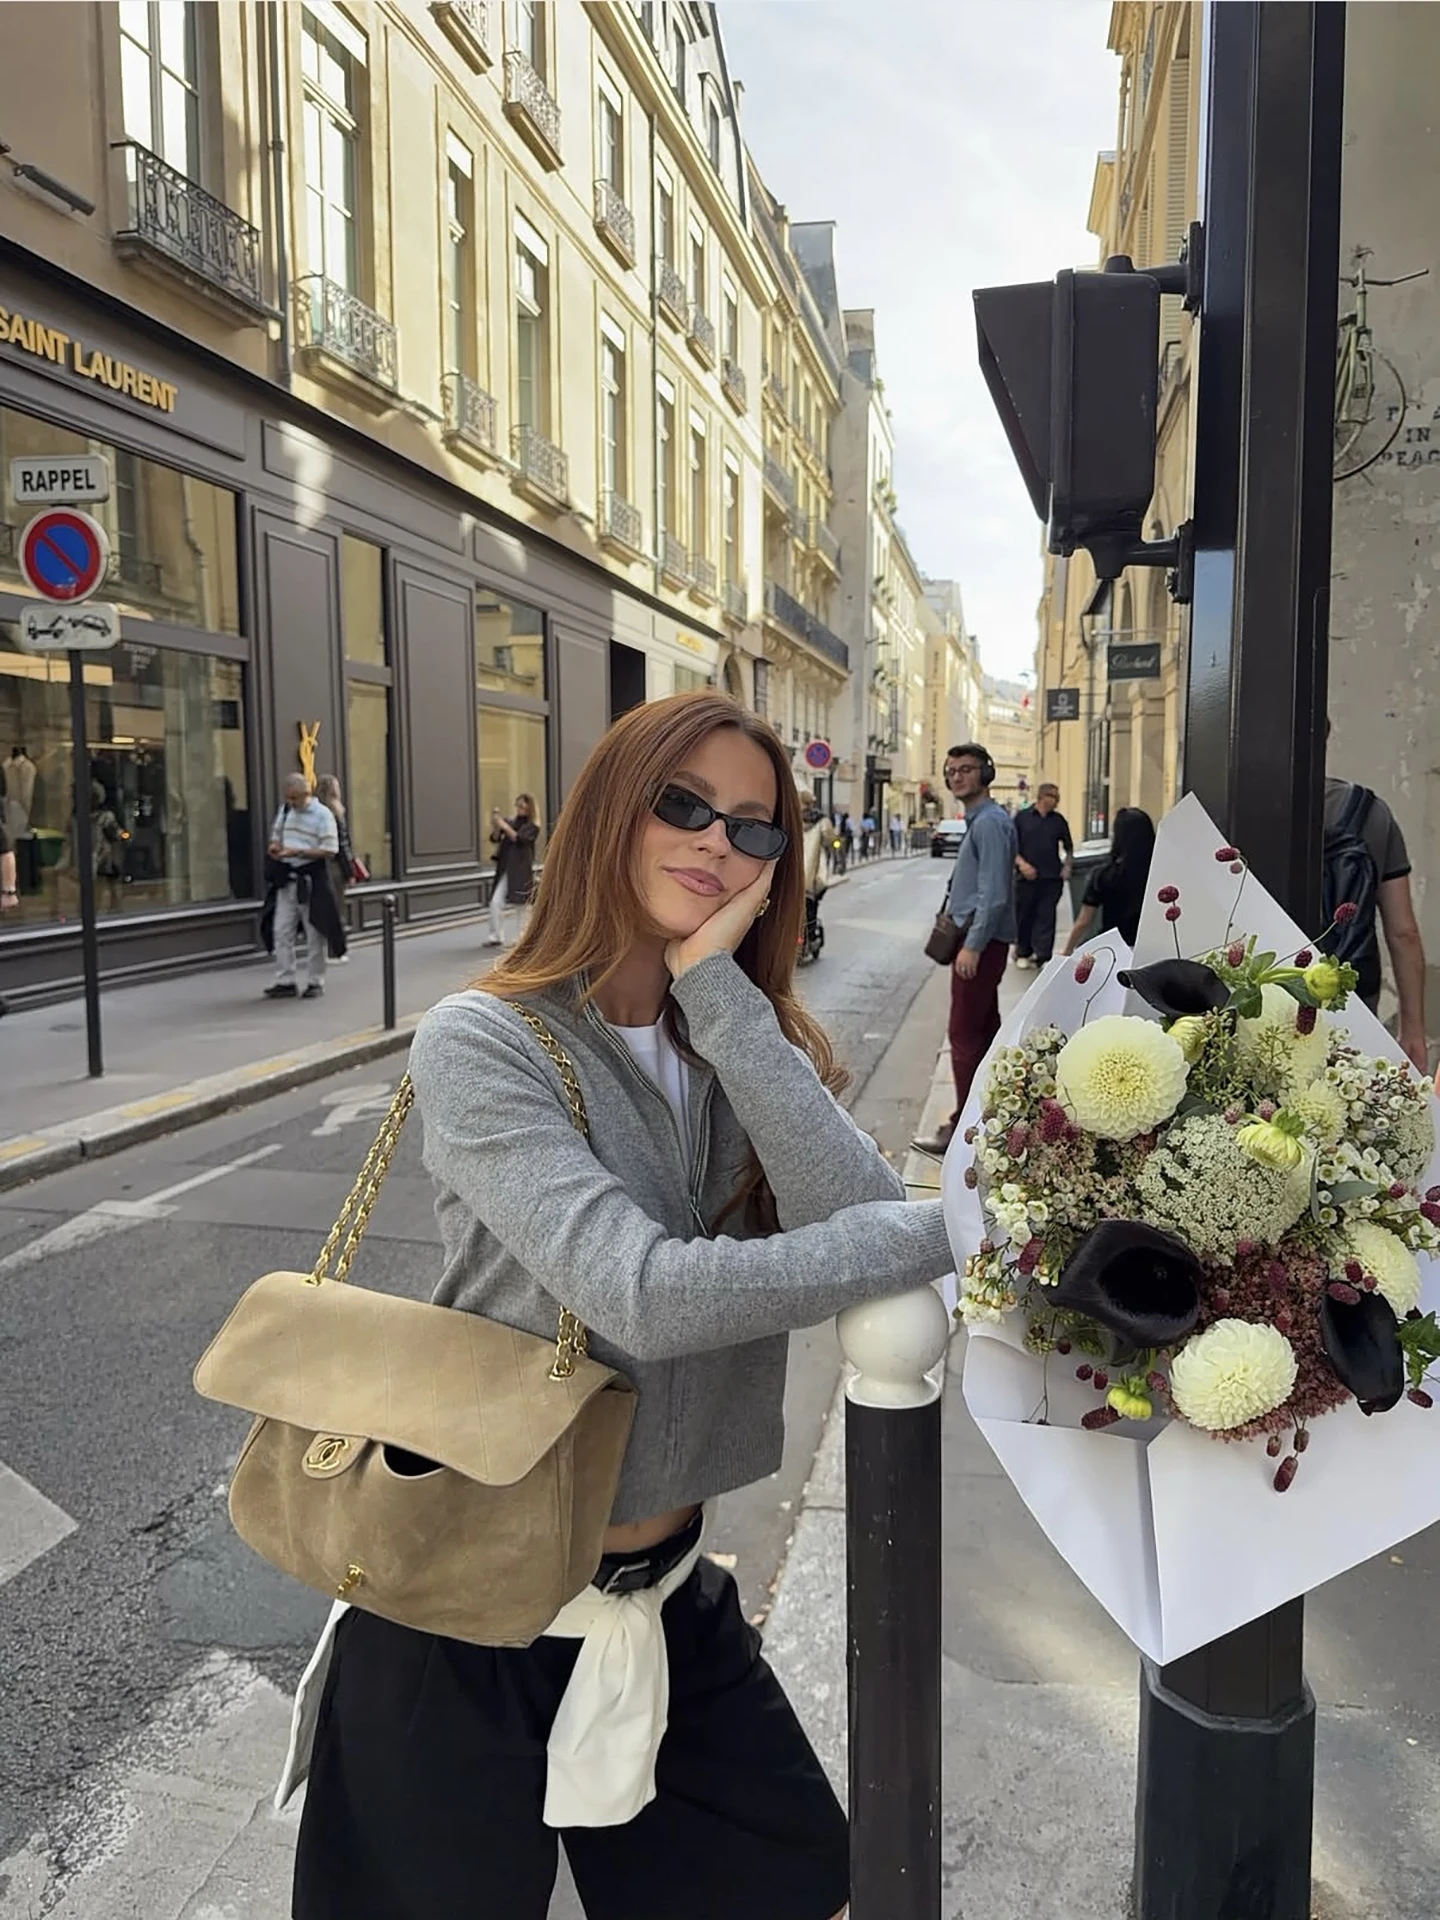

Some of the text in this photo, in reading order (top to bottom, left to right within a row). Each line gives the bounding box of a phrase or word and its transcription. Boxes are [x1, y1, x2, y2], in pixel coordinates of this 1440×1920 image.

[0, 306, 178, 413] SAINT LAURENT
[1406, 427, 1431, 443] IN
[21, 468, 97, 493] RAPPEL
